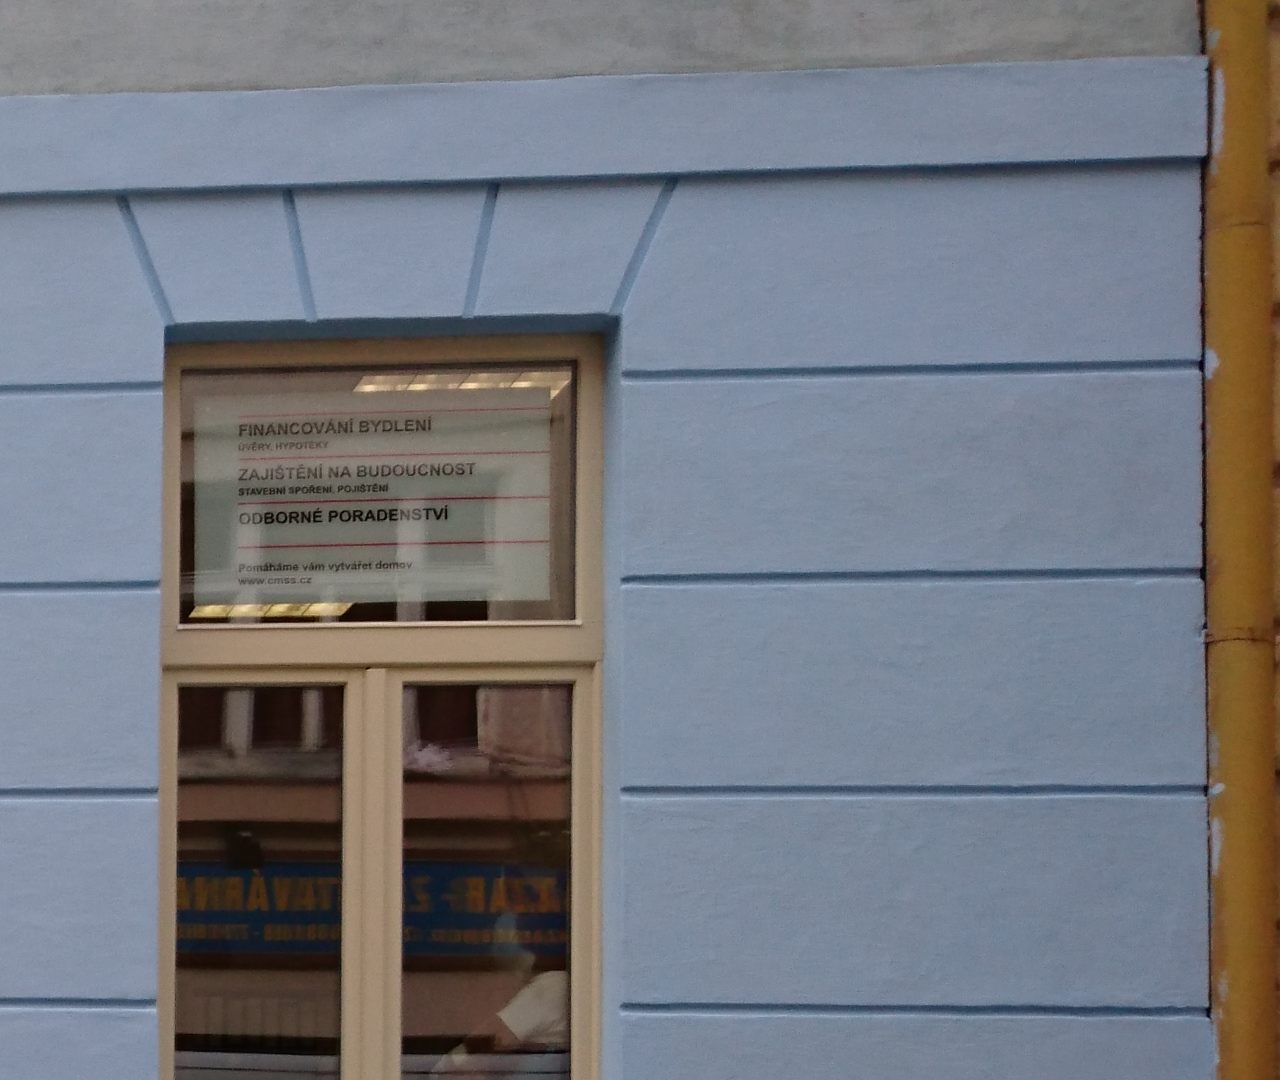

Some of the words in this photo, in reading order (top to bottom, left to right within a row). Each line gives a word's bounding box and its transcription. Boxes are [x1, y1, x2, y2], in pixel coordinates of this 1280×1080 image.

[238, 418, 354, 437] FINANCOVÁNÍ
[359, 416, 432, 434] BYDLENÍ
[237, 463, 324, 481] ZAJIŠTĚNÍ
[328, 466, 352, 479] NA
[357, 462, 477, 478] BUDOUCNOST
[238, 485, 287, 496] STAVEBNÍ
[337, 482, 389, 494] POJIŠTĚNÍ
[239, 507, 323, 525] ODBORNÉ
[328, 505, 449, 523] PORADENSTVÍ
[238, 562, 299, 573] Pomáháme
[301, 561, 325, 571] vám
[375, 559, 413, 571] domov
[238, 576, 313, 586] www.cmss.cz
